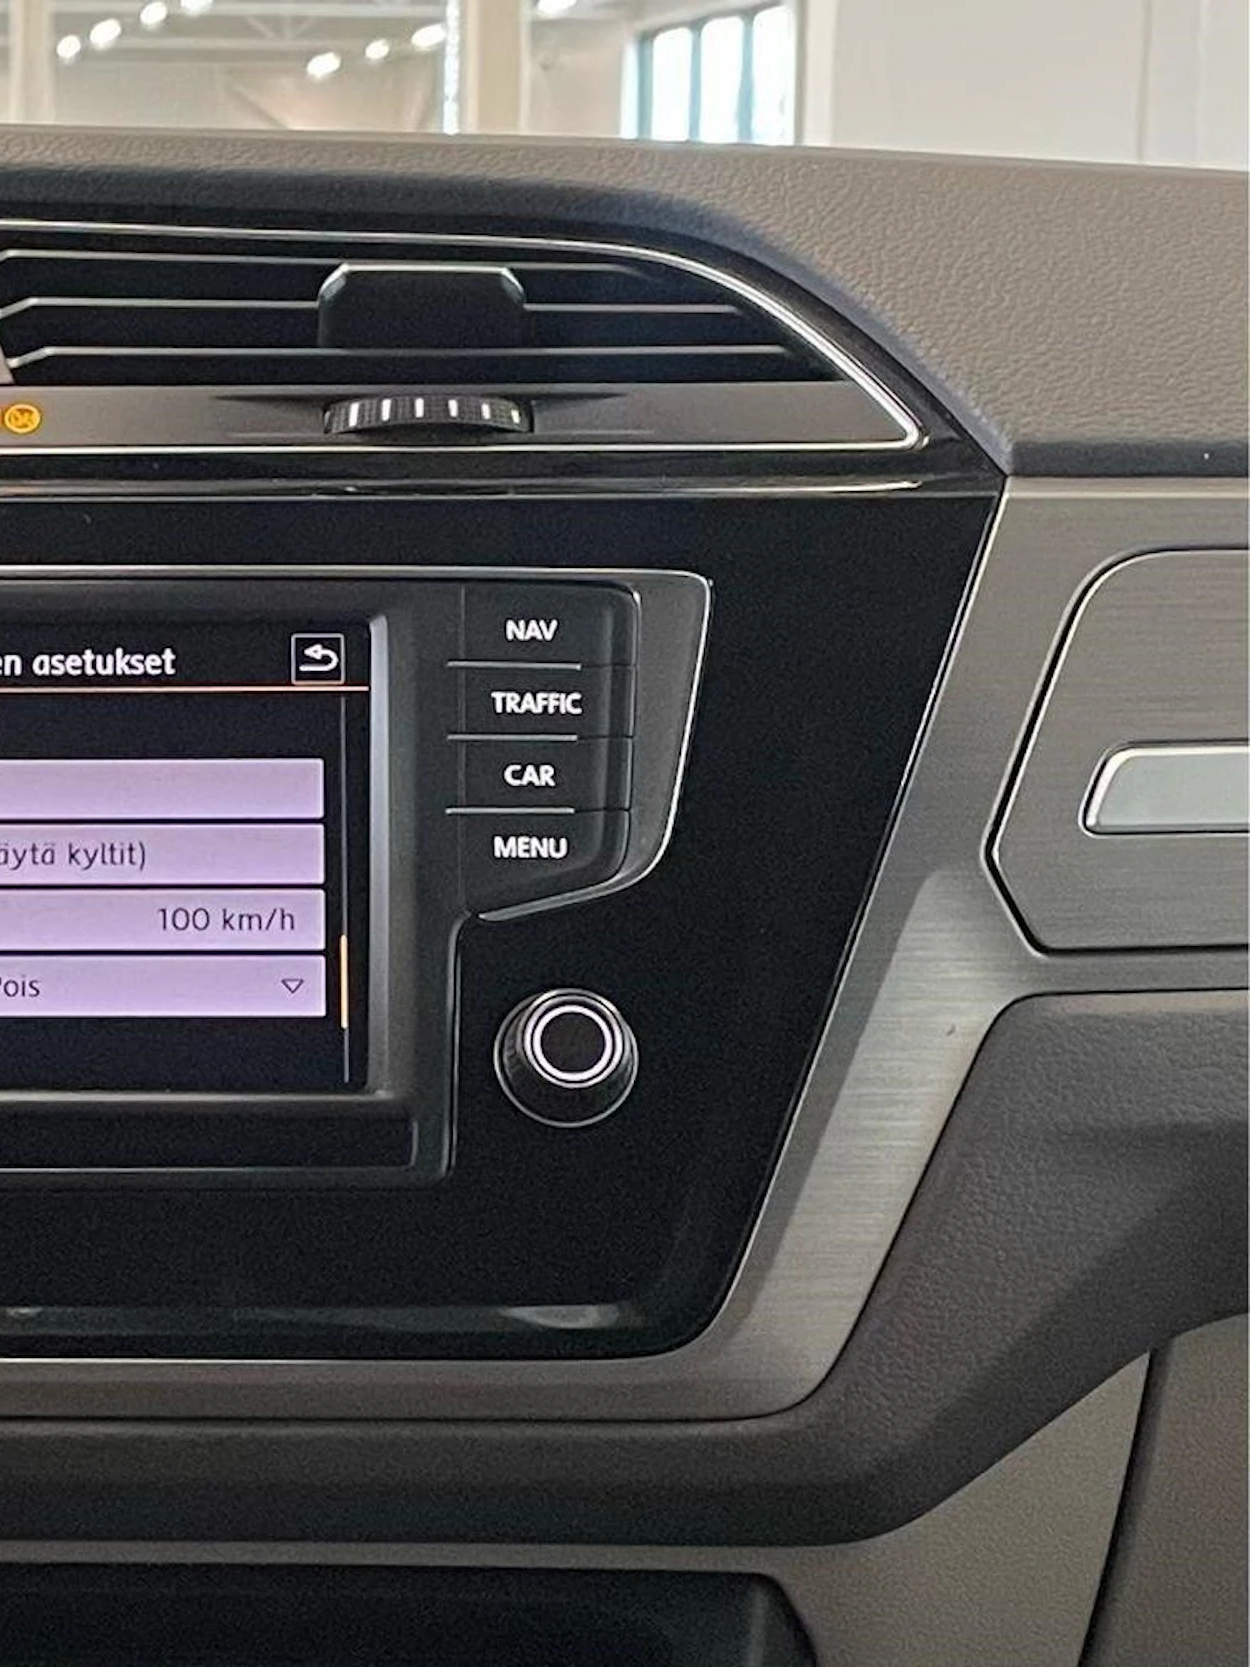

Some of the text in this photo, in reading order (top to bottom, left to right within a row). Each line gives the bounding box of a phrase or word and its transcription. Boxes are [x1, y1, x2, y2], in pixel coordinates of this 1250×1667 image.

[505, 619, 558, 641] NAV
[32, 647, 176, 676] asetukset
[490, 691, 583, 715] TRAFFIC
[504, 764, 556, 787] CAR
[67, 841, 147, 873] kyltit)
[493, 836, 568, 859] MENU
[158, 907, 296, 933] 100 km/h
